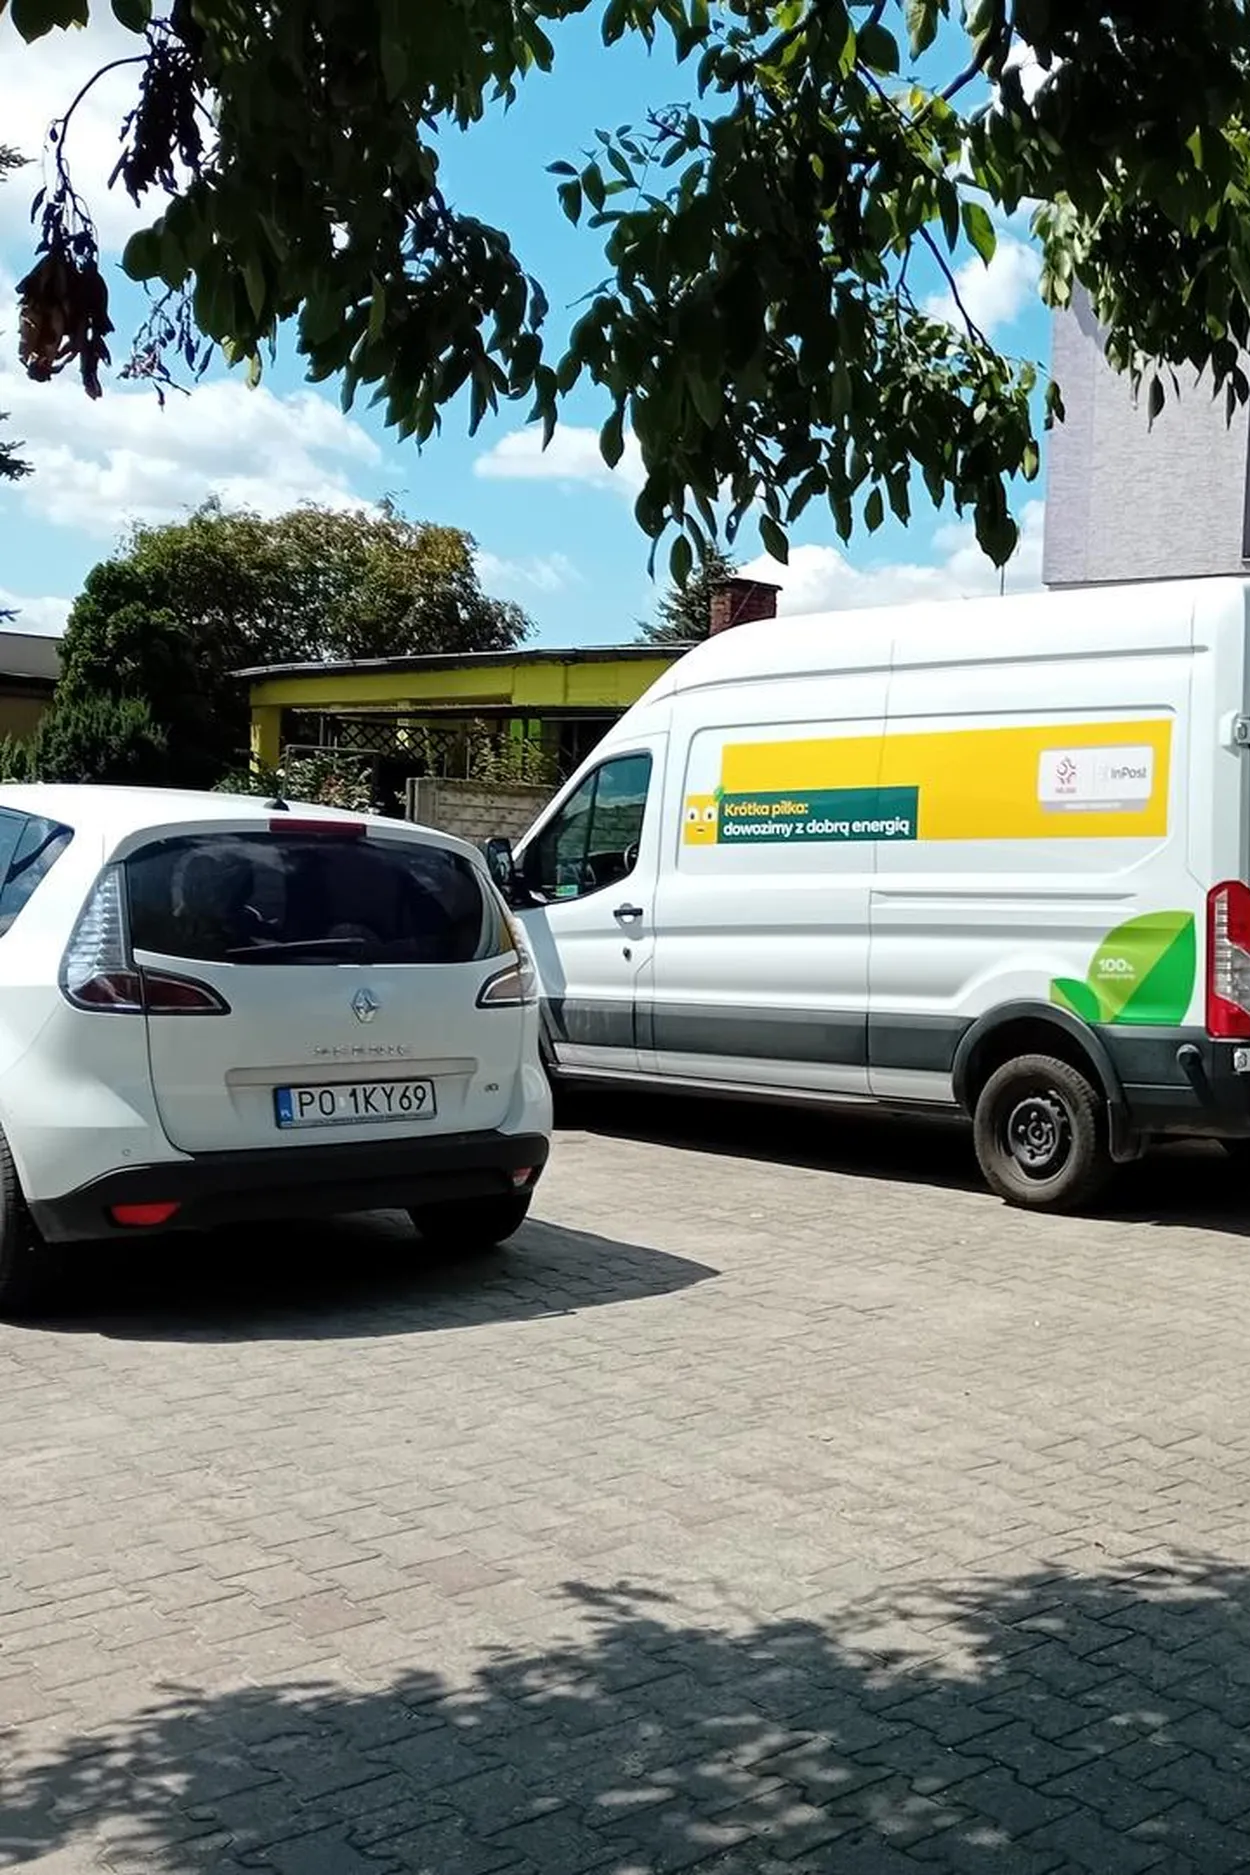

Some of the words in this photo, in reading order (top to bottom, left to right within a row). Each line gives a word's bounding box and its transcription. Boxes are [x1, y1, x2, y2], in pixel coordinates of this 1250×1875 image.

[724, 802, 770, 817] Krótka
[723, 820, 794, 837] dowozimy
[794, 822, 804, 834] z
[806, 818, 850, 836] dobrą
[851, 816, 910, 835] energią
[348, 1085, 427, 1114] 1KY69
